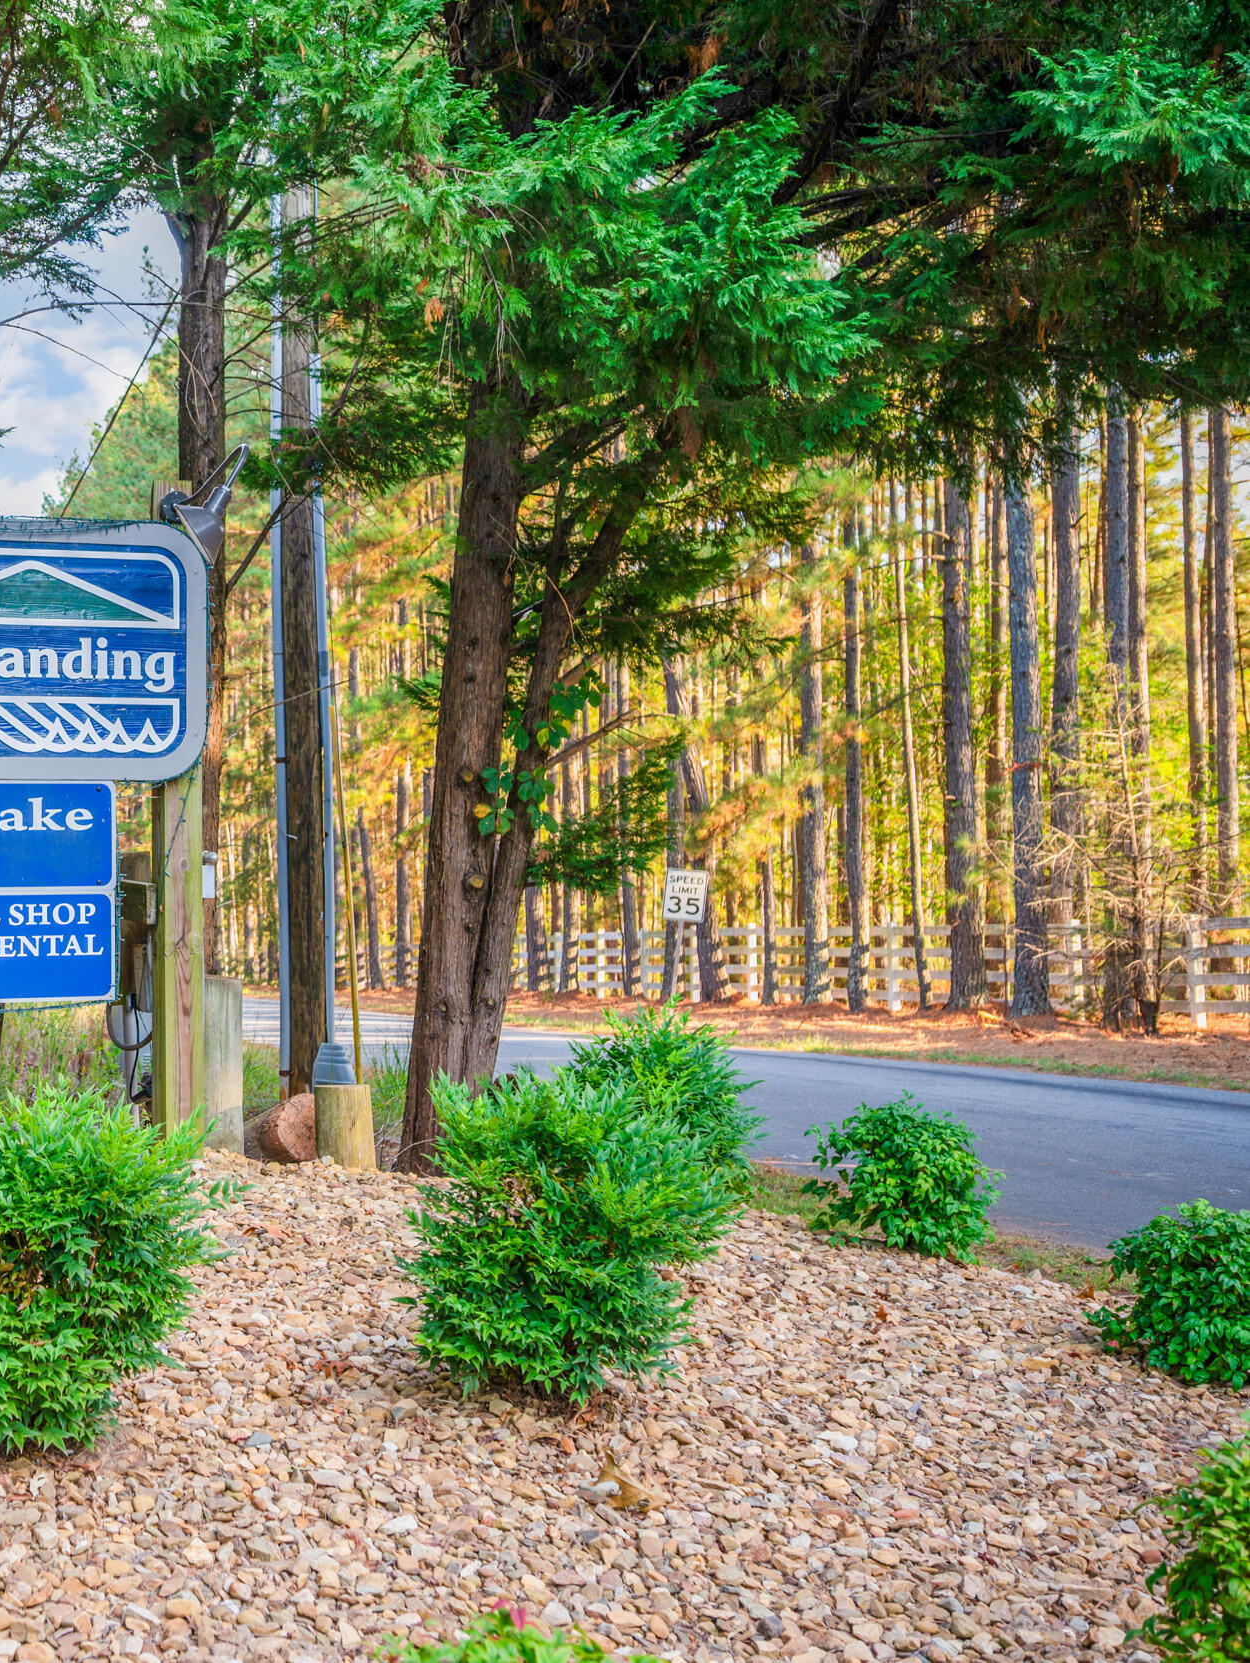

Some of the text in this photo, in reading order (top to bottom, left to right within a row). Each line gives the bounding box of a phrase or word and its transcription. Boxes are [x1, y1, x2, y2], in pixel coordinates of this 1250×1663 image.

[669, 874, 704, 885] SPEED
[671, 885, 698, 895] LIMIT
[667, 896, 700, 915] 35
[8, 902, 97, 926] SHOP
